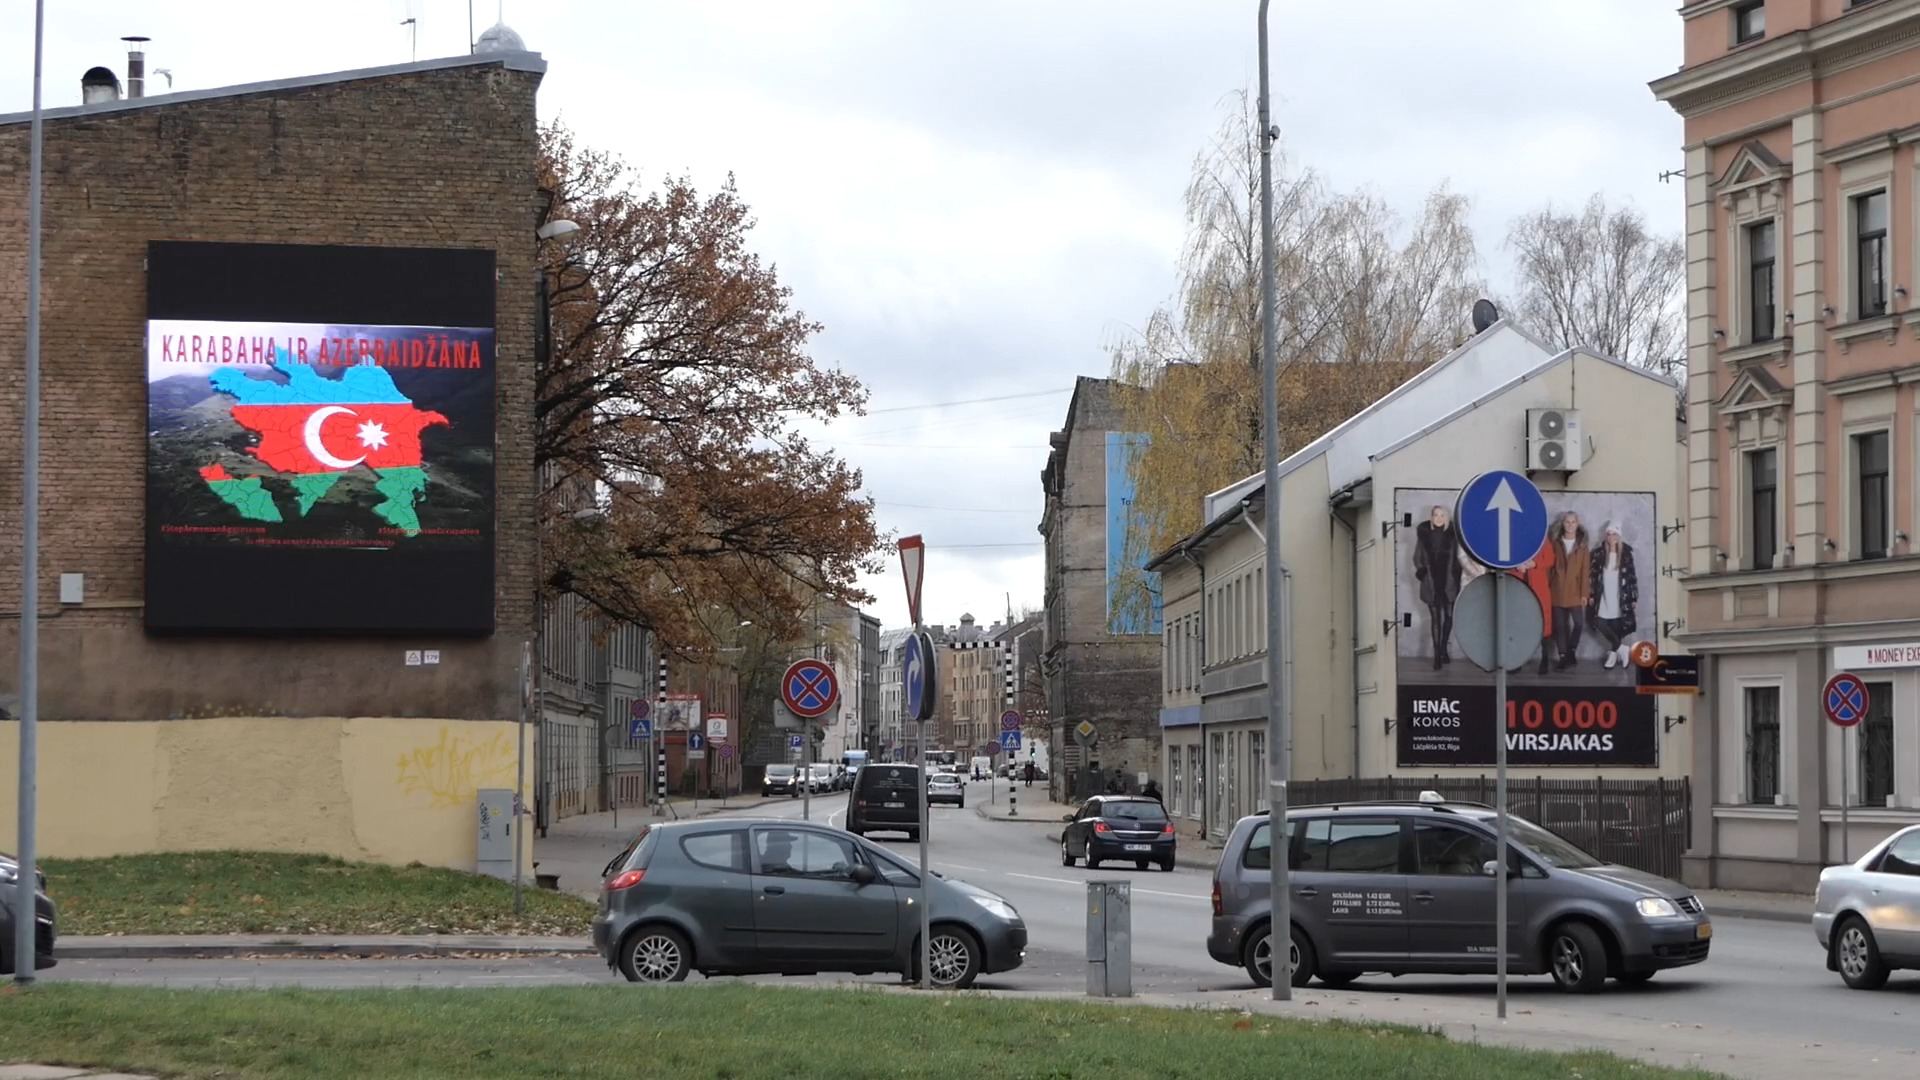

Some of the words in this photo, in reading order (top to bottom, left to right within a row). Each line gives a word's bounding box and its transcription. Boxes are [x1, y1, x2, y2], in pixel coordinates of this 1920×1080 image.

[162, 335, 276, 364] KARABAHA
[288, 337, 309, 365] IR
[317, 333, 481, 369] AZERBAIDŽĀNA
[1874, 647, 1904, 664] MONEY
[1413, 698, 1460, 714] IENĀC
[1505, 700, 1544, 729] 10
[1553, 700, 1618, 729] 000
[1413, 716, 1461, 728] KOKOS
[1505, 733, 1614, 751] VIRSJAKAS
